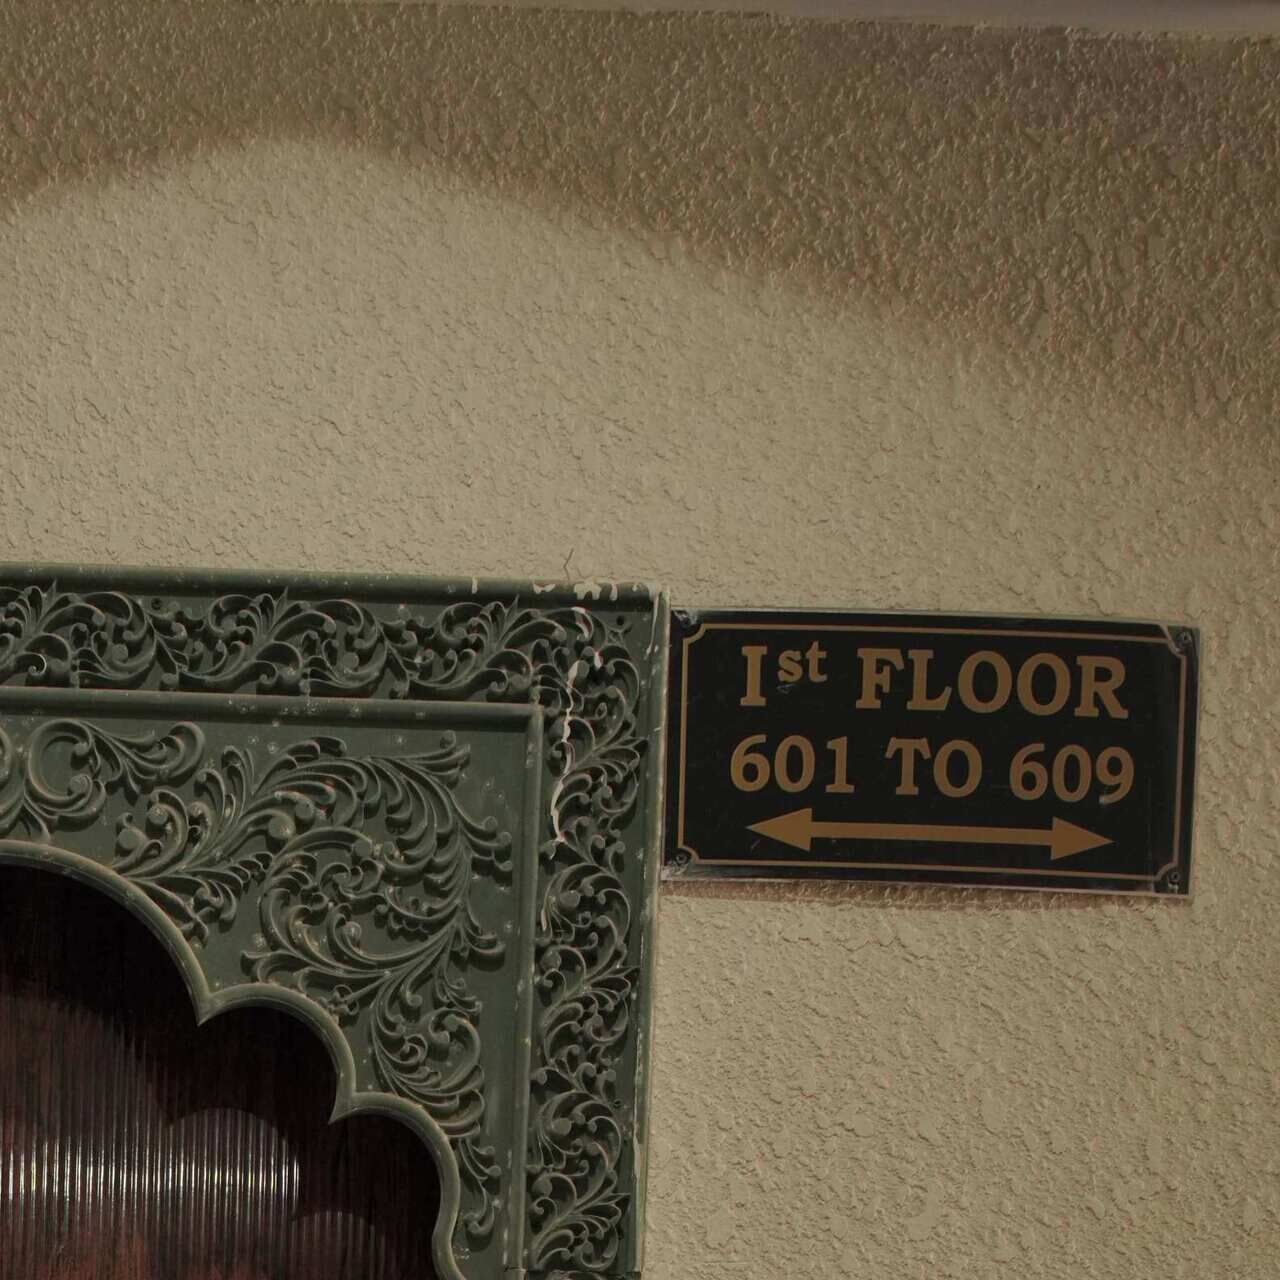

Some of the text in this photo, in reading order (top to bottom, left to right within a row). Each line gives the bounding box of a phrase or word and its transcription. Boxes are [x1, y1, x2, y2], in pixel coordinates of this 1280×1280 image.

[855, 647, 1129, 720] FLOOR
[729, 734, 1135, 806] 601 TO 609
